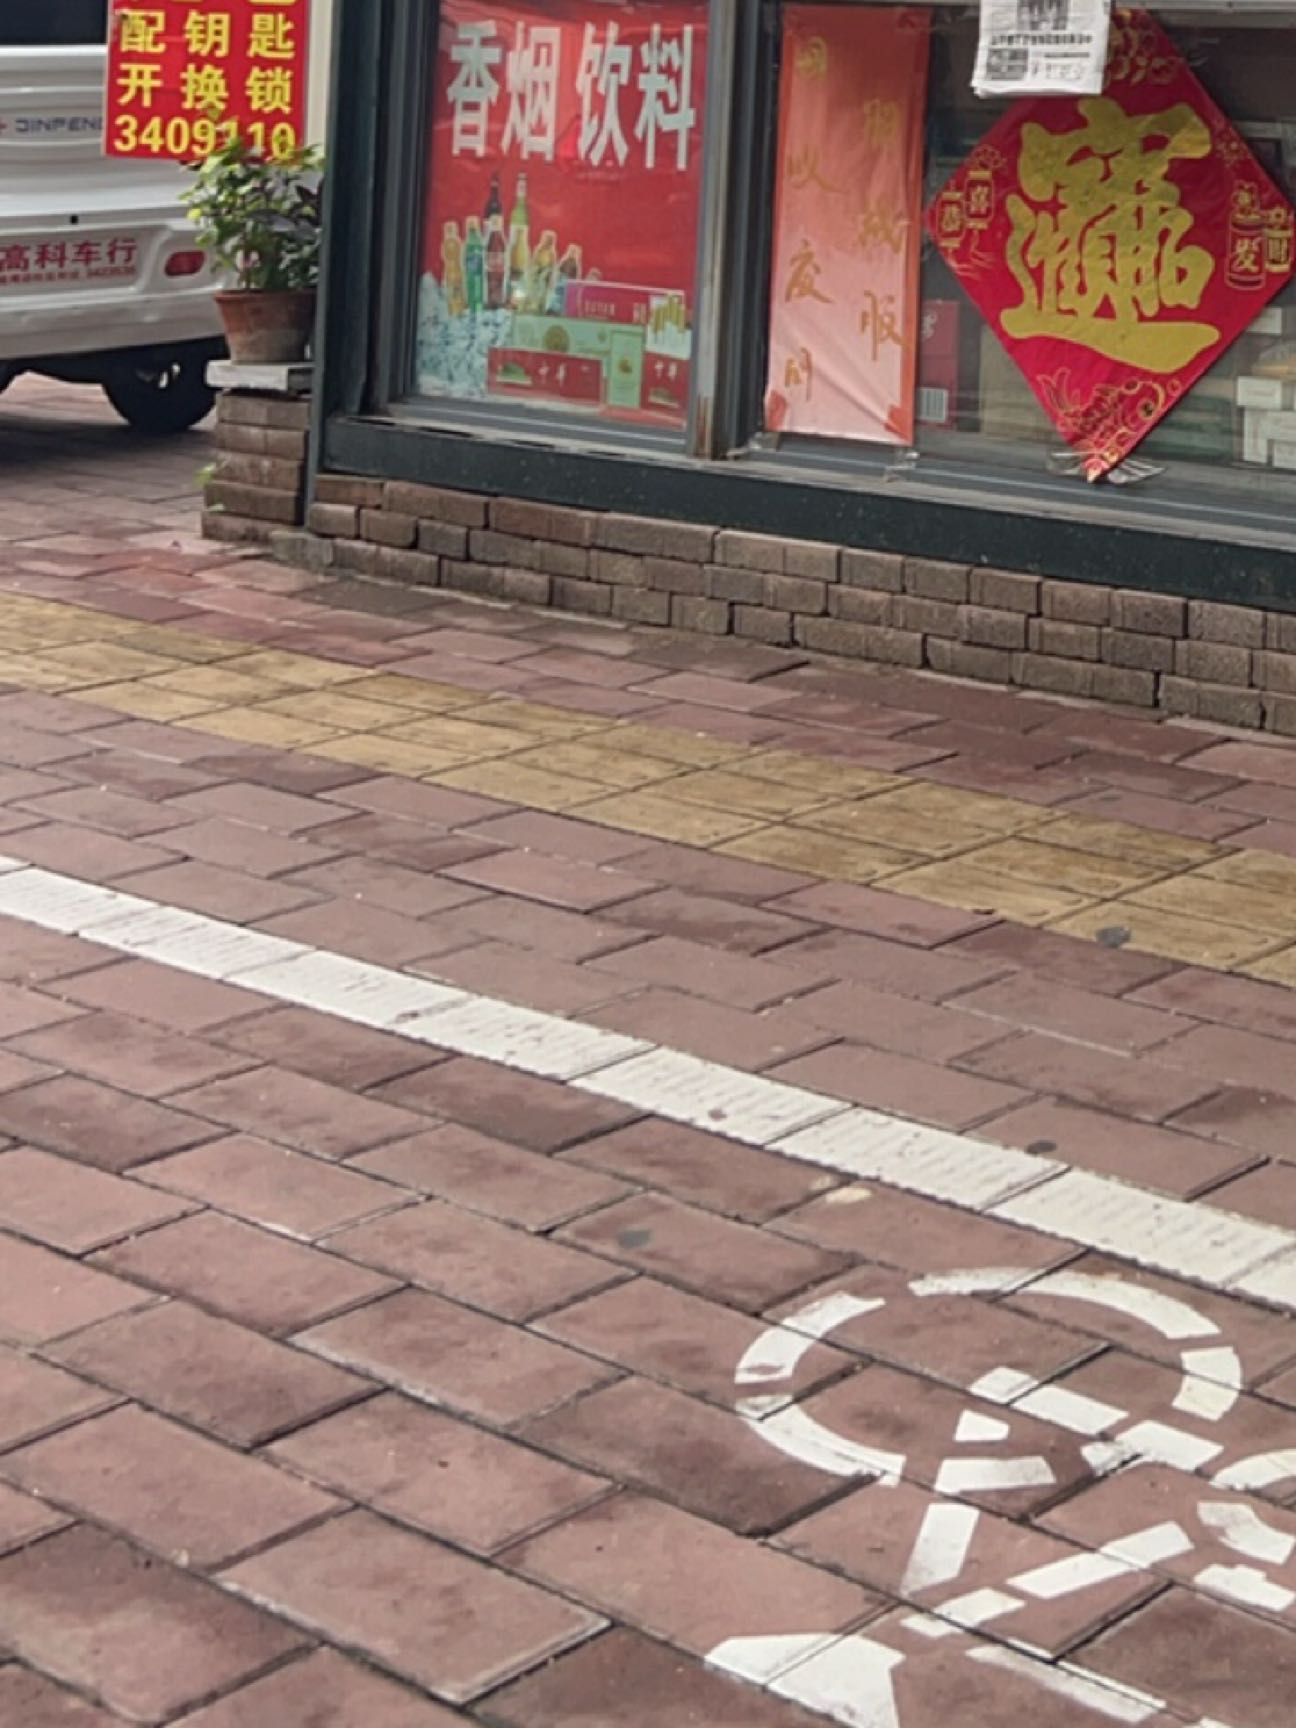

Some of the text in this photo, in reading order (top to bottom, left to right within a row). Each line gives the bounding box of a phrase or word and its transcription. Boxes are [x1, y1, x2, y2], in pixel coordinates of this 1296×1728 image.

[118, 9, 295, 59] 配钥匙
[116, 62, 293, 114] 开换锁
[446, 19, 695, 171] 香烟 饮料
[15, 116, 104, 133] JINPEN
[0, 237, 137, 271] 高科车行
